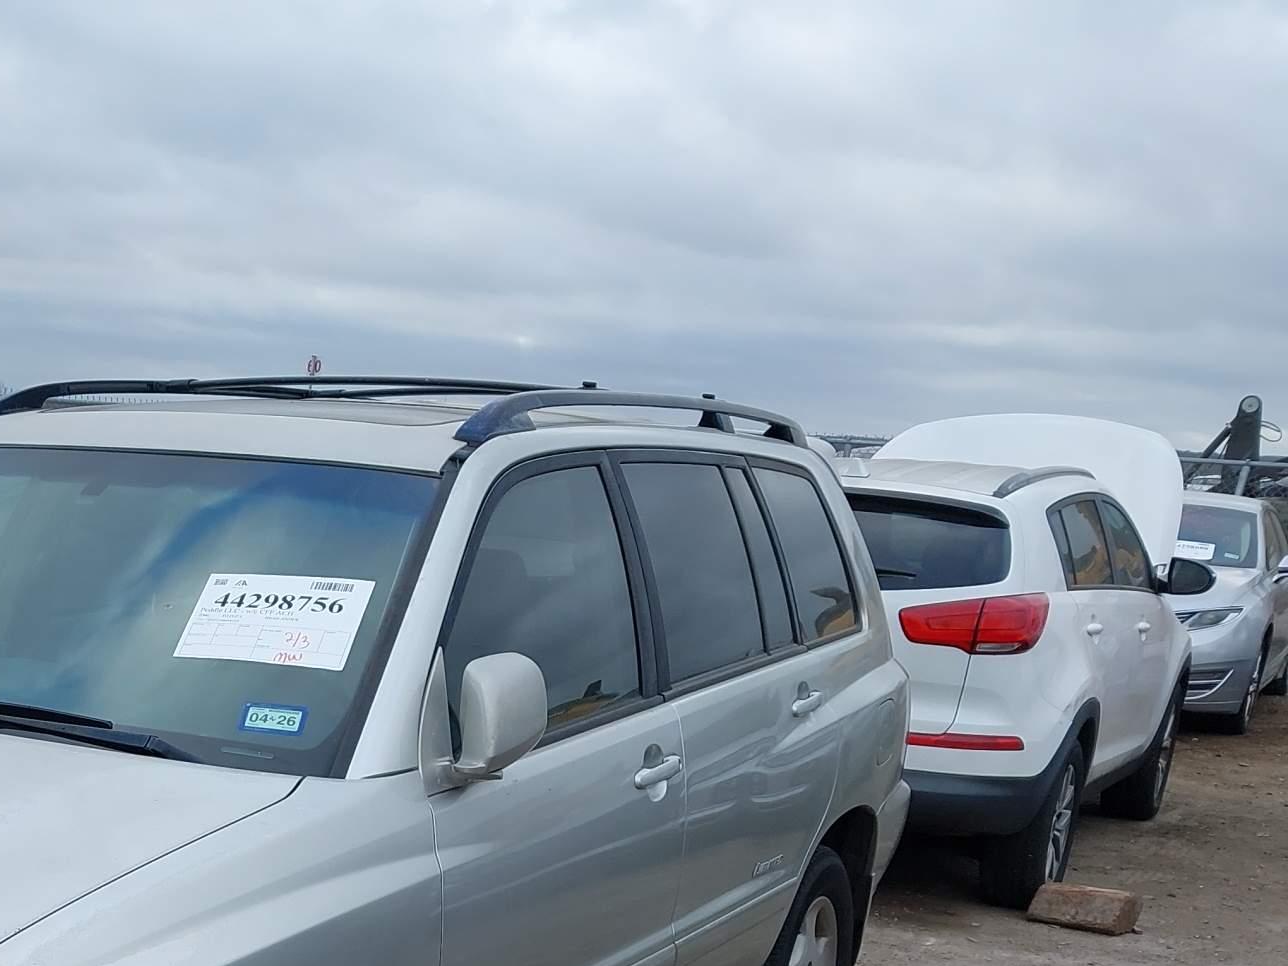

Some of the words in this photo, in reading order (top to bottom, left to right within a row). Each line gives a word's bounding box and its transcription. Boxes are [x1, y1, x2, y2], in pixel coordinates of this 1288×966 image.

[214, 592, 347, 614] 44298756
[249, 712, 269, 724] 04
[276, 715, 297, 727] 26
